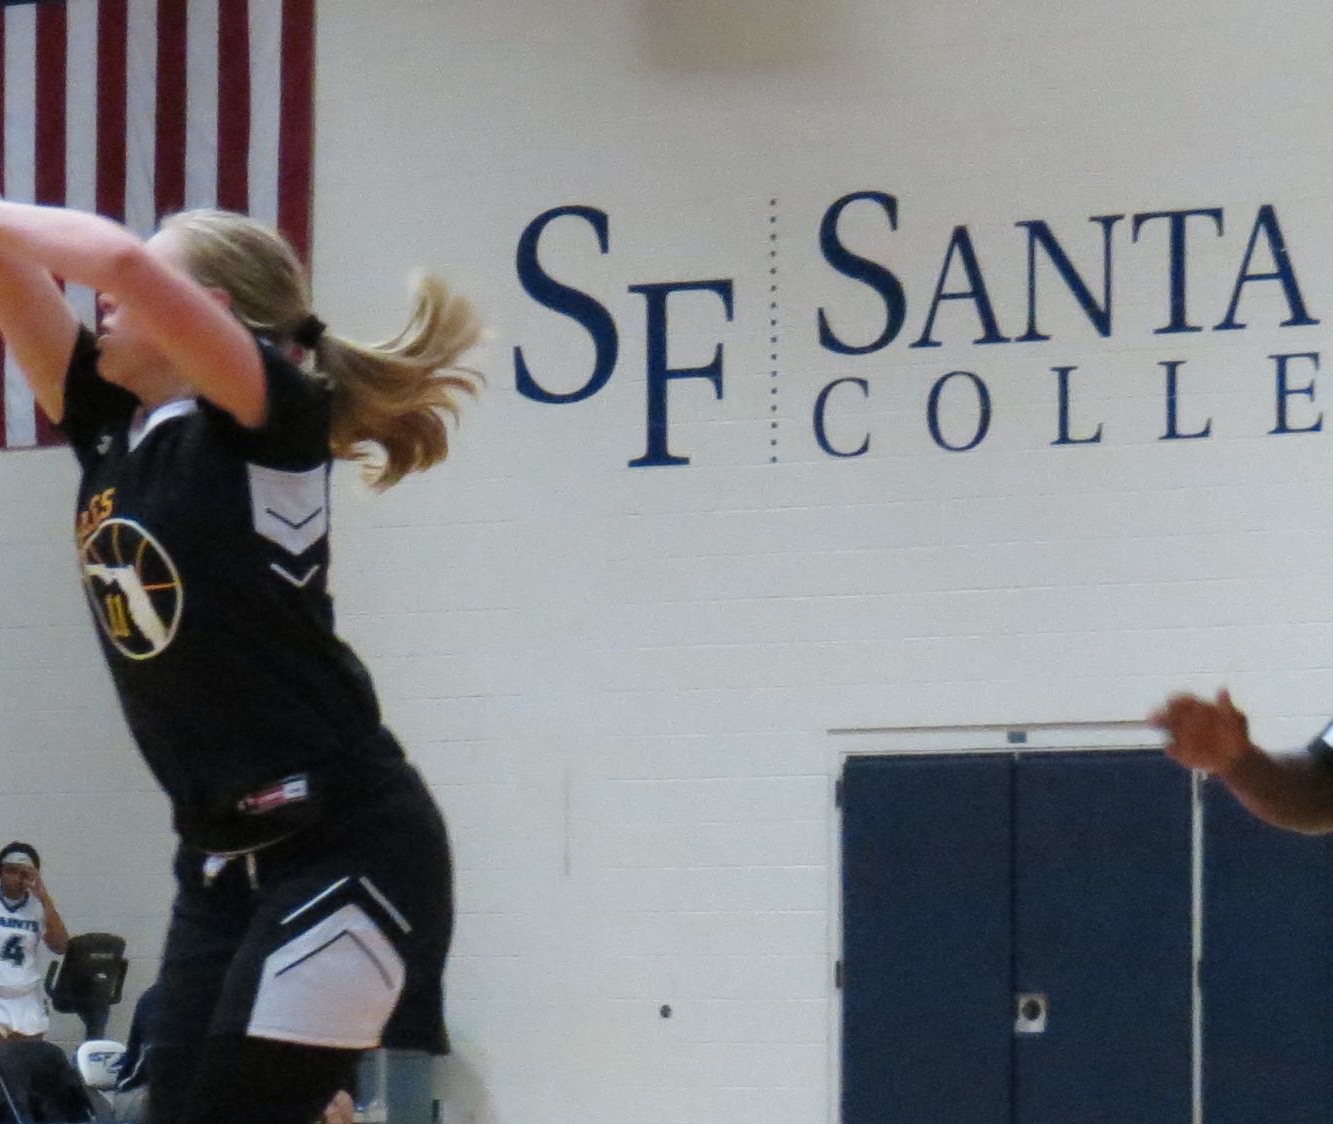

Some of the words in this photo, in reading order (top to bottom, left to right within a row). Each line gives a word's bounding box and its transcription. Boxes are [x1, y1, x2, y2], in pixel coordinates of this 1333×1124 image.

[512, 204, 736, 469] SF
[815, 190, 1321, 356] SANTA
[813, 352, 1325, 458] COLLE
